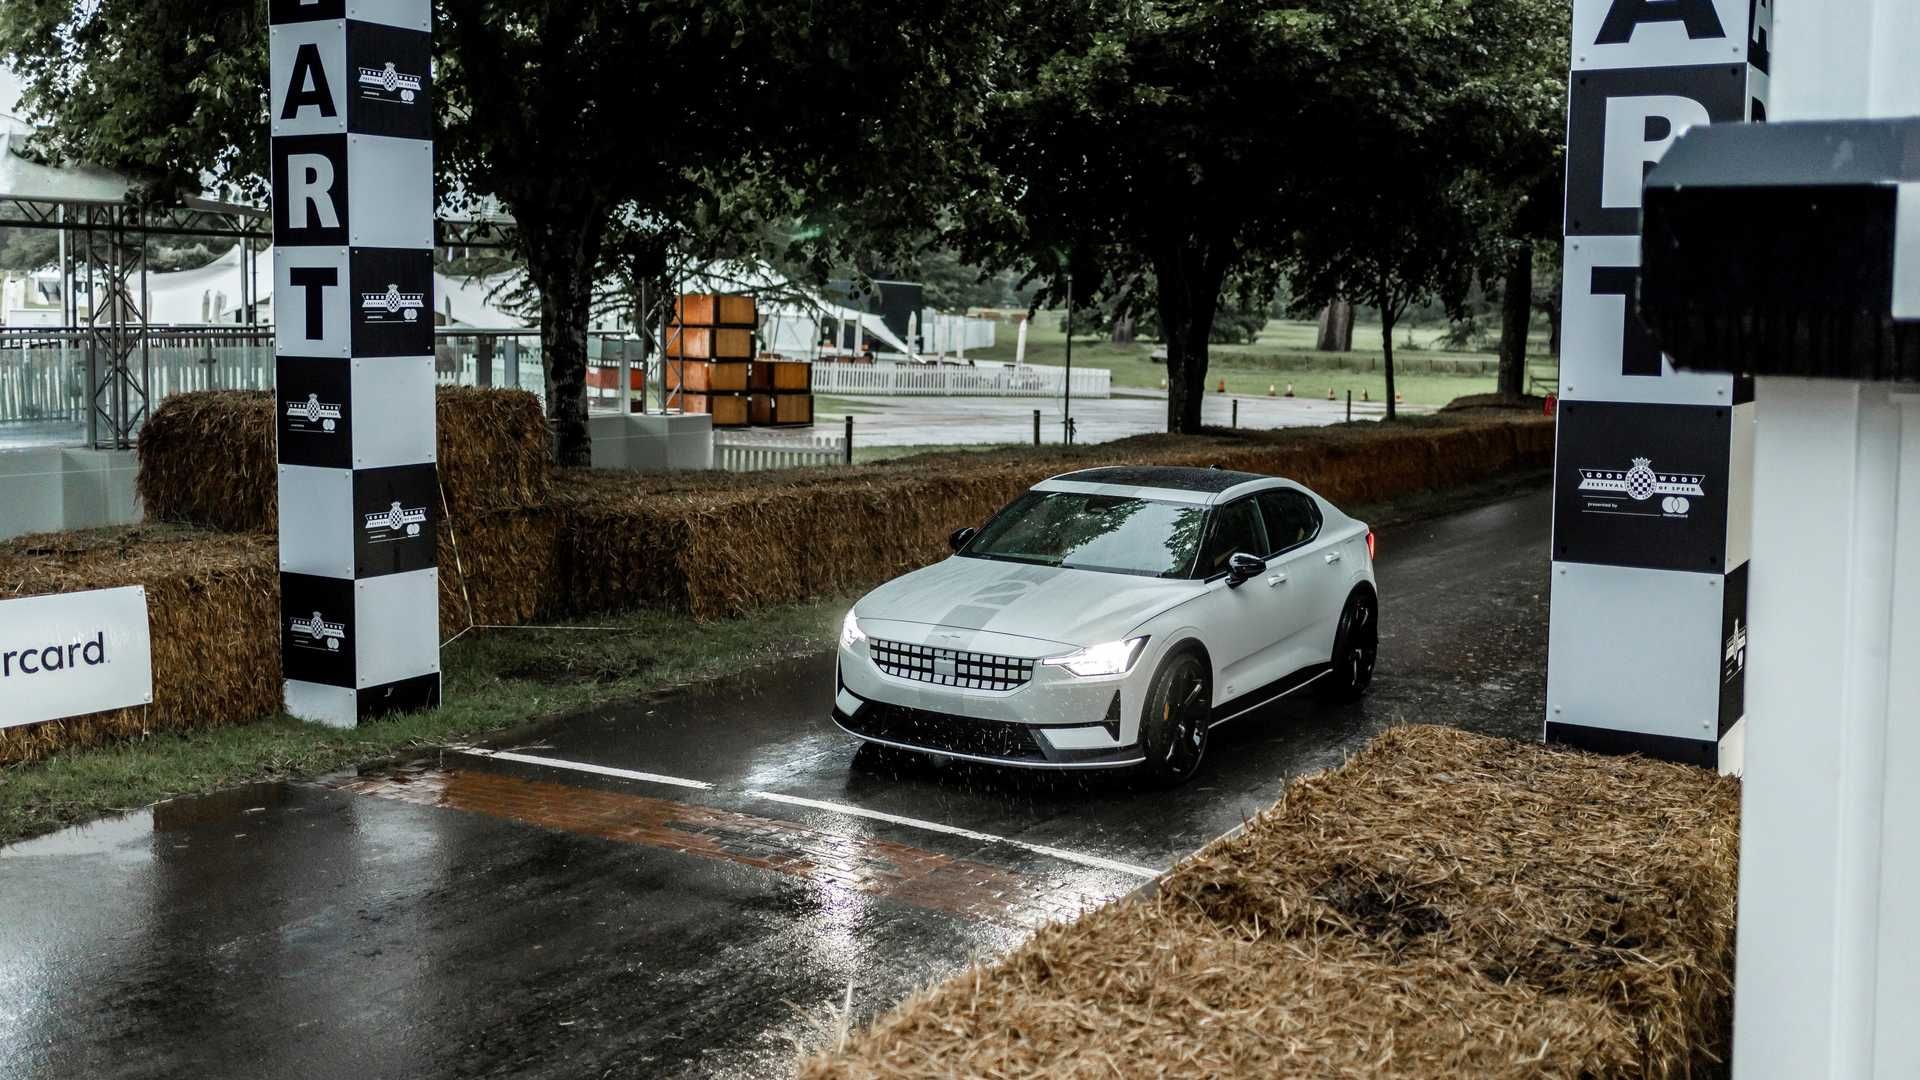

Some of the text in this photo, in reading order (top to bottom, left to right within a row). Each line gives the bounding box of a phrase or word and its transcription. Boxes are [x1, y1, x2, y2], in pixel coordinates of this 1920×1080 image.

[280, 0, 340, 340] ART
[1586, 472, 1698, 483] GOOD WOOD
[3, 631, 105, 677] rcard
